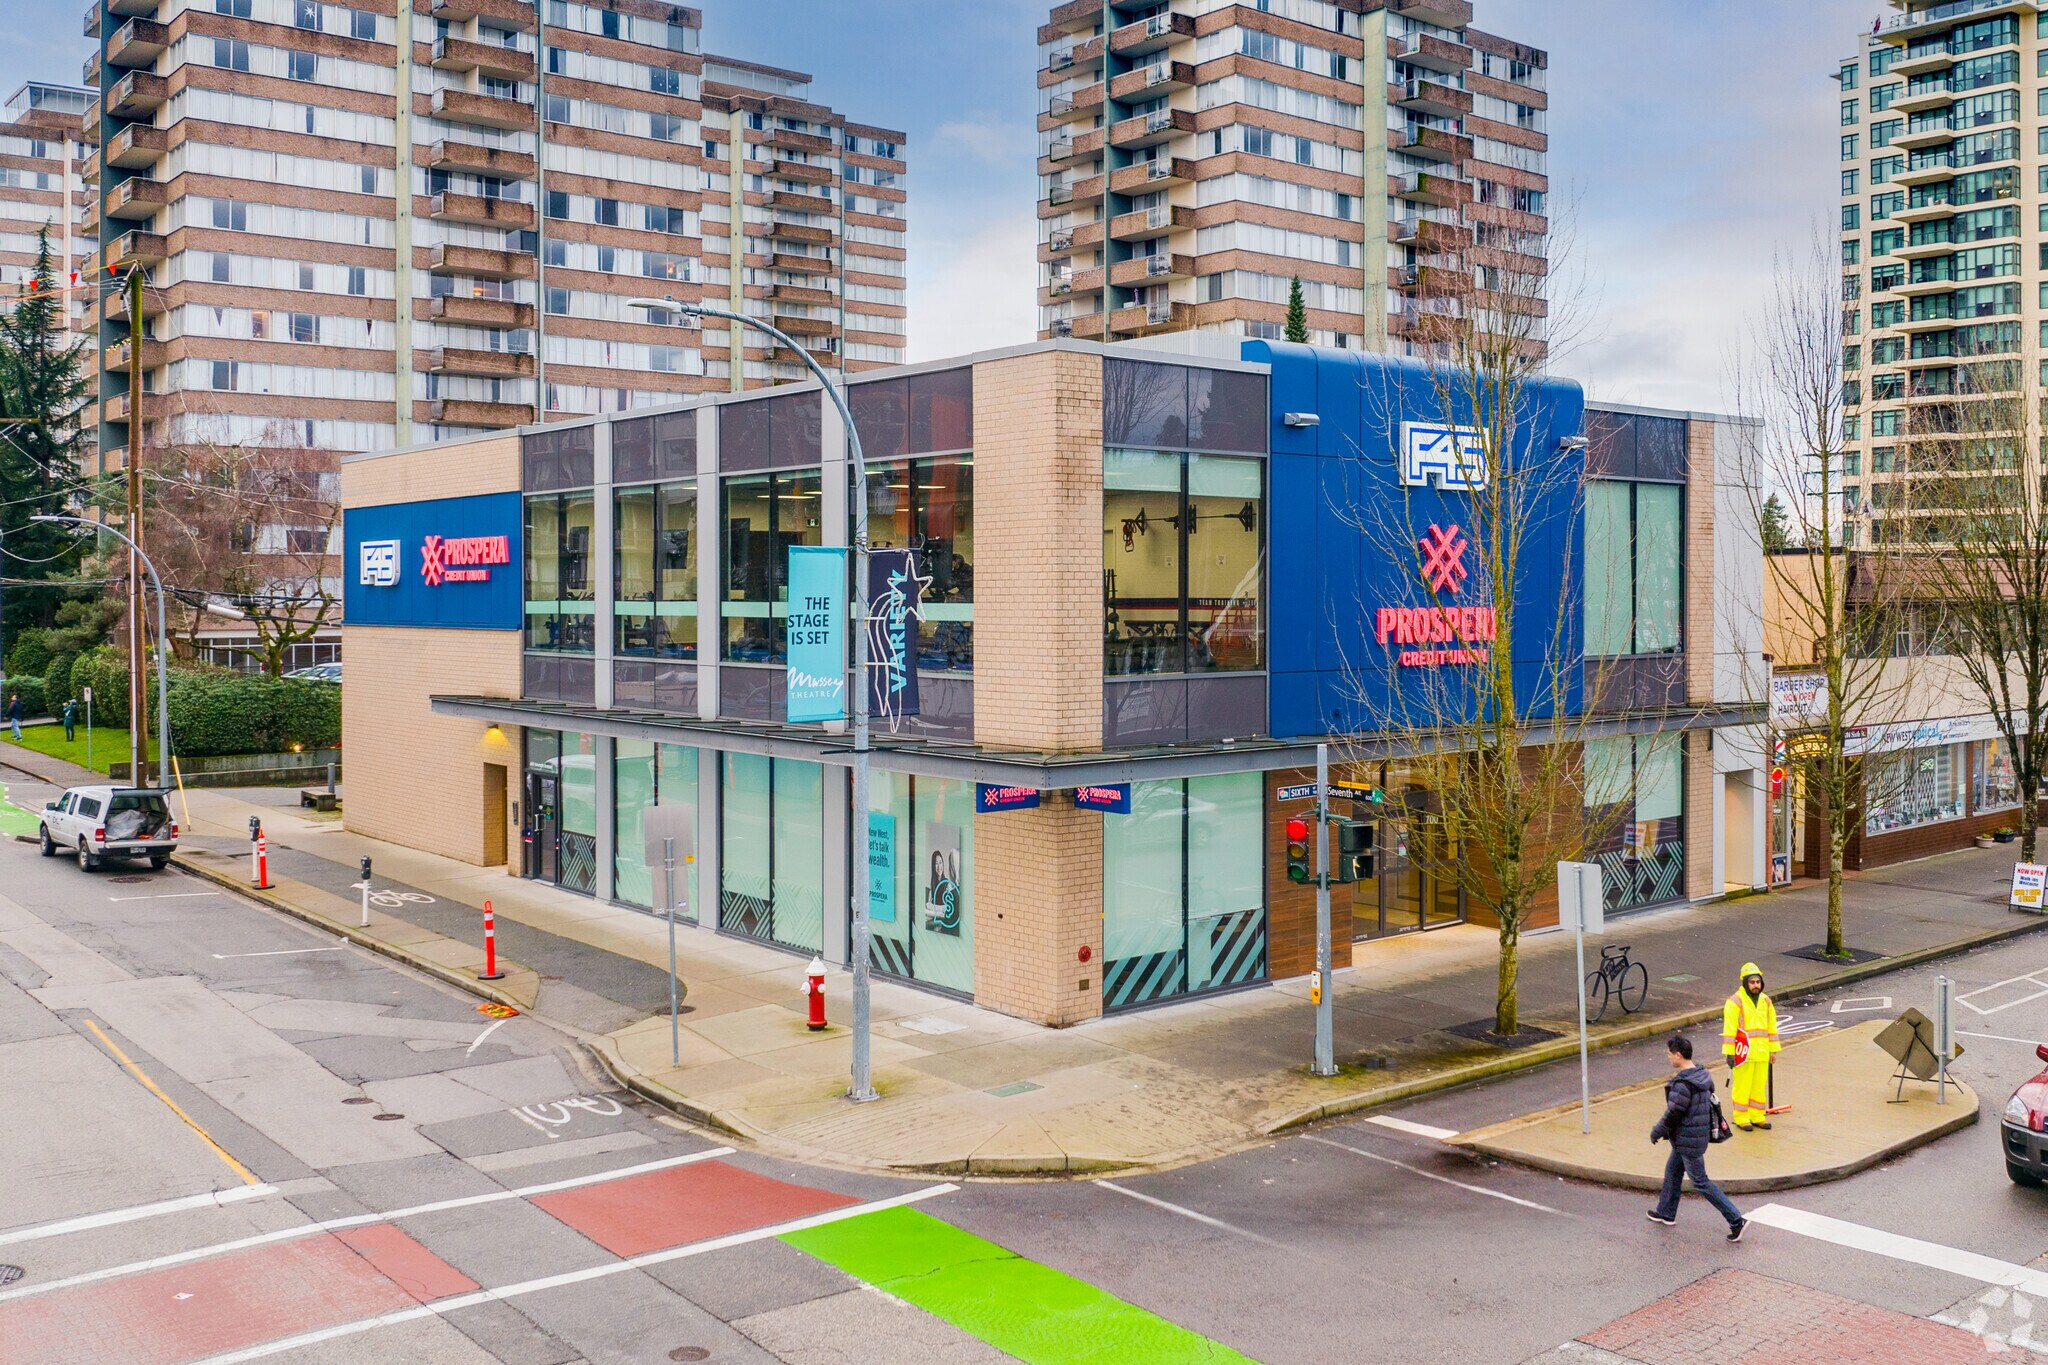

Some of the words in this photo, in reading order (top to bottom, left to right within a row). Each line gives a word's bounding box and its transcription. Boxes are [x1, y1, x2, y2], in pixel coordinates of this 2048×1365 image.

[1402, 422, 1489, 490] F45
[444, 535, 509, 565] PROSPERA
[360, 540, 399, 586] F45
[444, 570, 466, 581] CREDIT
[467, 569, 488, 581] UNION
[805, 597, 830, 610] THE
[788, 614, 829, 628] STAGE
[791, 632, 804, 645] IS
[807, 631, 829, 645] SET
[889, 569, 907, 693] VARIETY
[791, 690, 832, 699] THEATRE
[999, 786, 1037, 798] PROSPERA
[1089, 787, 1122, 801] PROSPERA
[1290, 787, 1310, 797] SIXTH
[1327, 786, 1353, 798] Seventh
